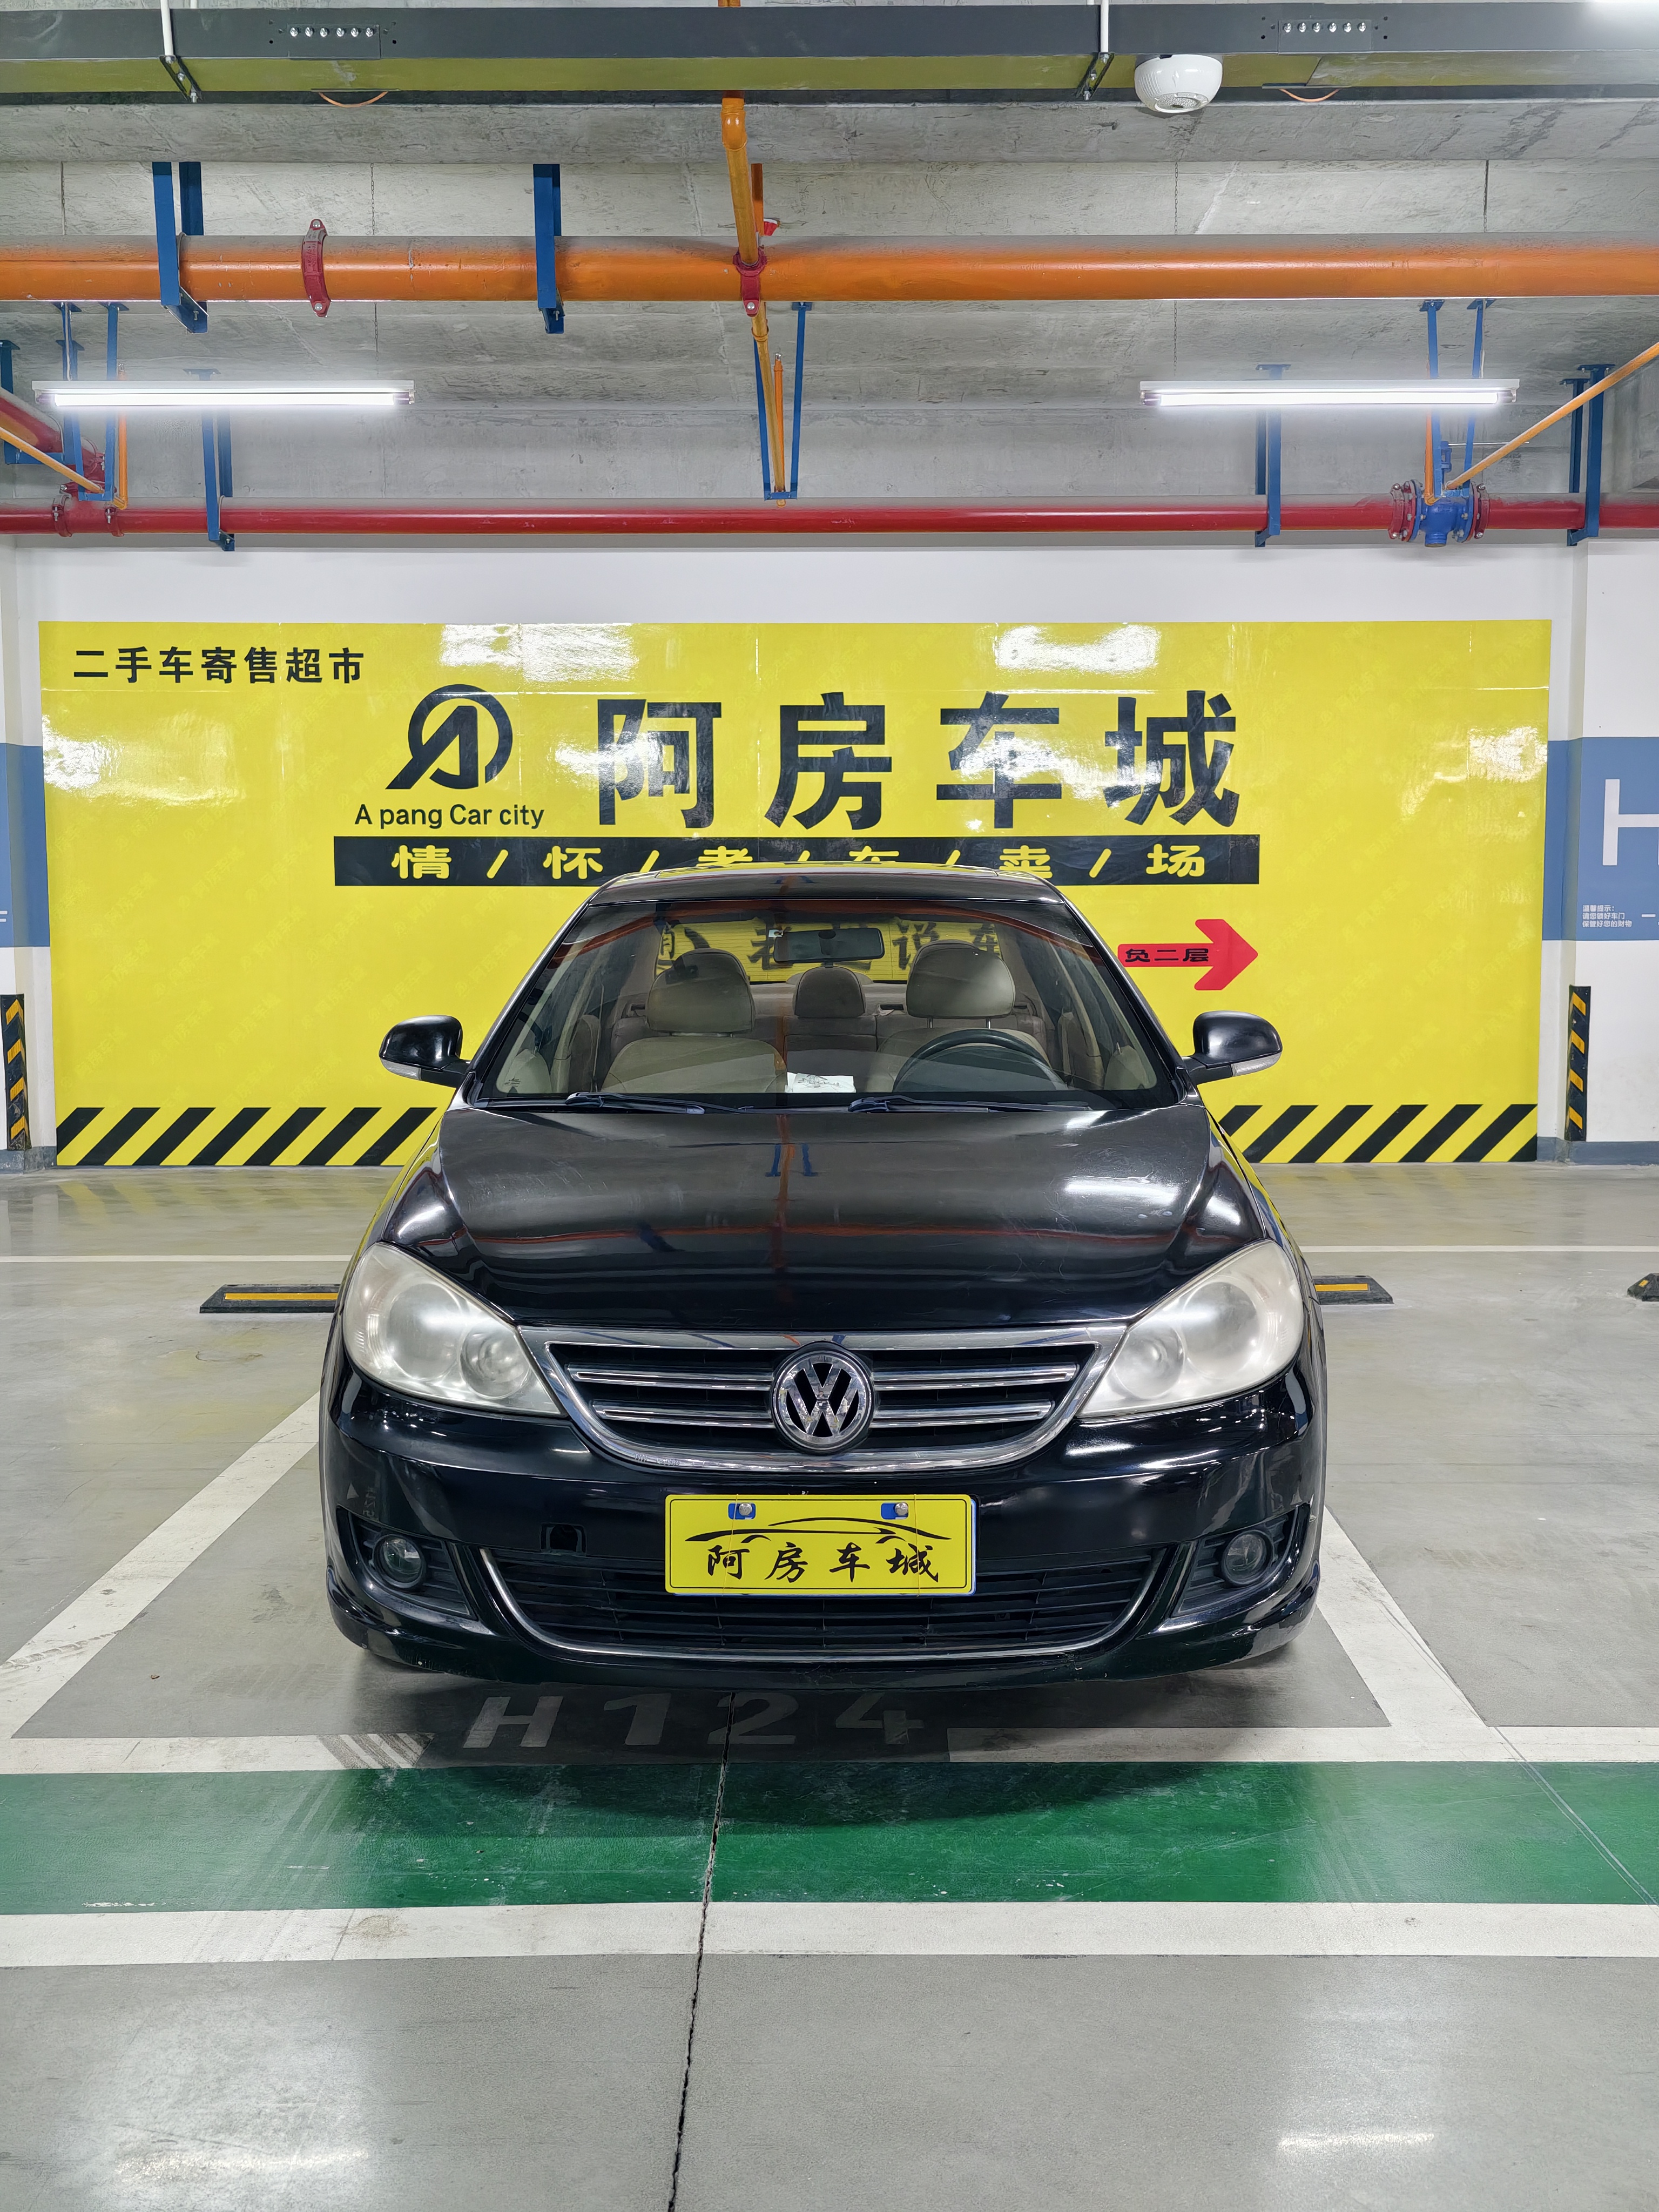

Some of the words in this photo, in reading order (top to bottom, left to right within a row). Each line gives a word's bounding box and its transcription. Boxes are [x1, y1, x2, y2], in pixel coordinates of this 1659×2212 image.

[73, 646, 365, 684] 二手车寄售超市
[597, 691, 1241, 830] 阿房车城
[355, 804, 373, 825] A
[380, 809, 442, 830] pang
[450, 804, 493, 825] Car
[500, 804, 545, 830] city
[1125, 948, 1209, 962] 负二层
[707, 1542, 939, 1583] 阿房车城
[463, 1692, 924, 1749] H124
